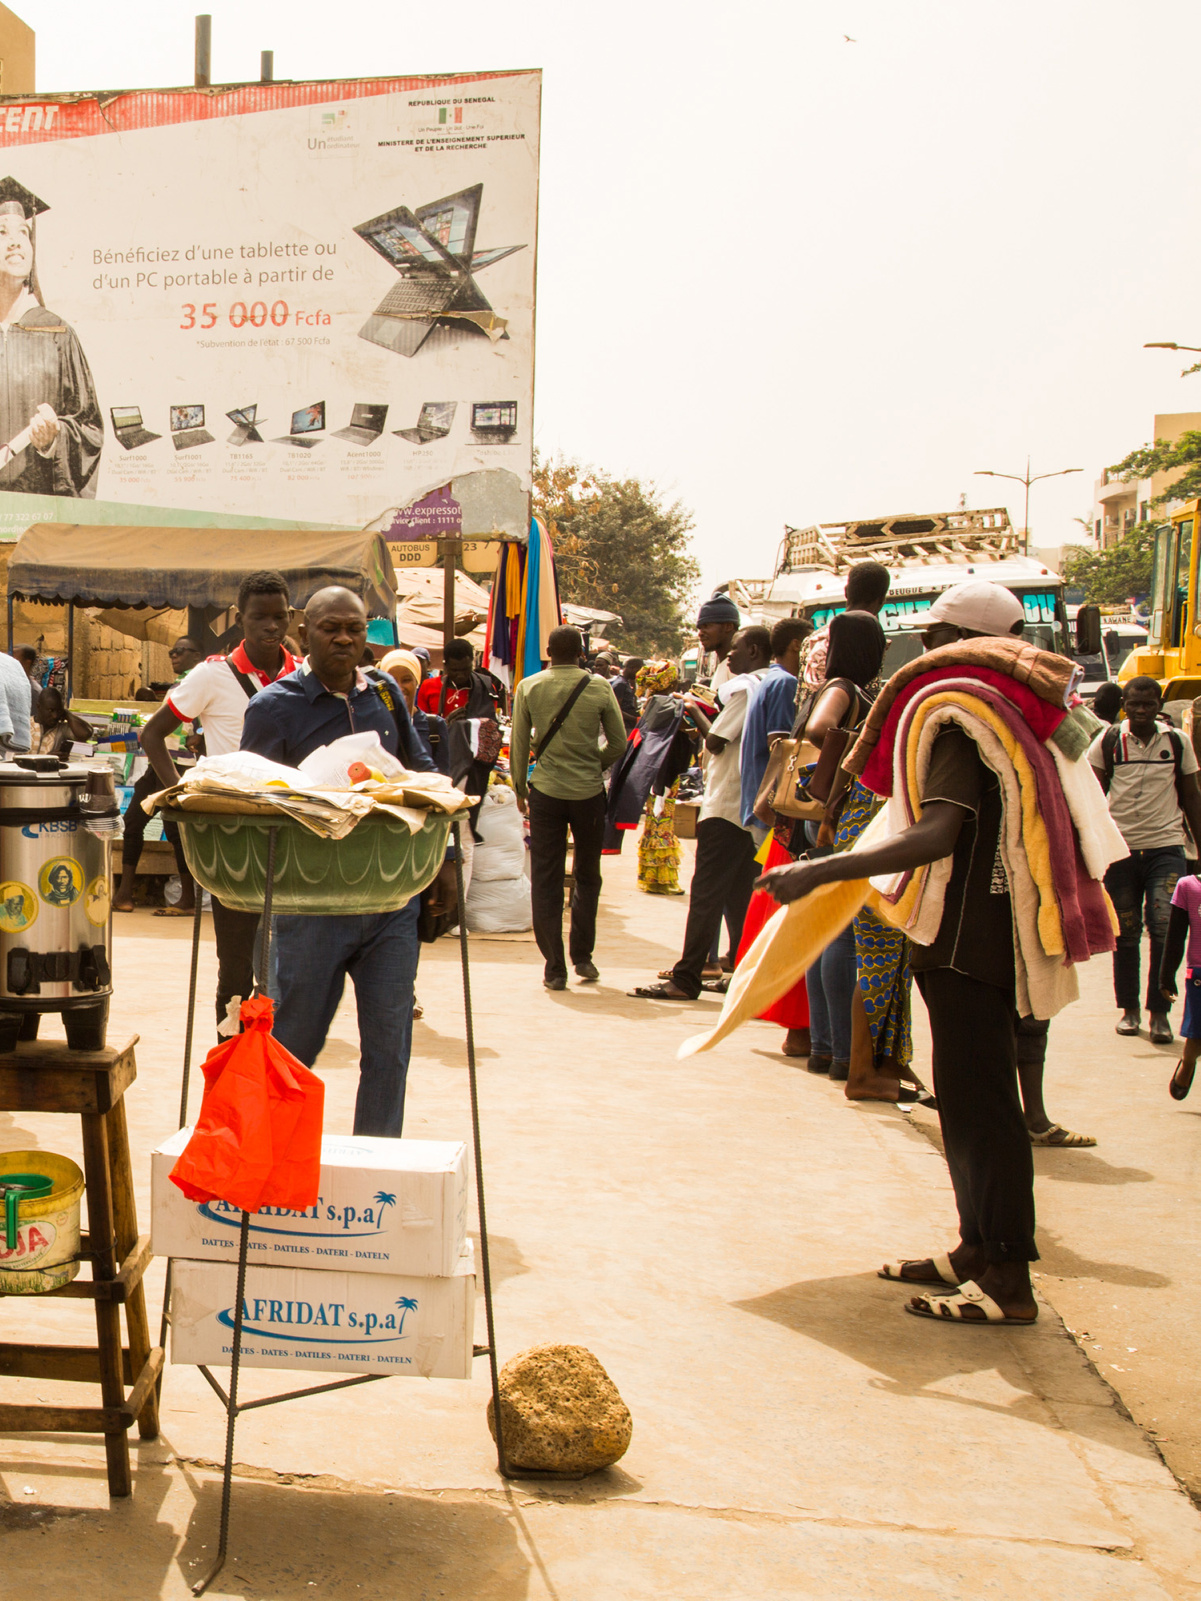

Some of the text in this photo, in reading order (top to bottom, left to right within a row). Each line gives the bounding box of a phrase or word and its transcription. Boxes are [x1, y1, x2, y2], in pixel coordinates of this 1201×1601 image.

[408, 98, 451, 107] REPUBLIQUE
[464, 96, 495, 104] SENEGAL
[308, 137, 326, 150] Un
[426, 136, 485, 145] L'ENSEIGNEMENT
[487, 134, 525, 142] SUPERIEUR
[446, 143, 487, 151] RECHERCHE
[93, 247, 180, 265] Bénéficiez
[240, 242, 309, 259] tablette
[314, 243, 337, 255] ou
[136, 272, 158, 288] PC
[164, 269, 238, 291] portable
[243, 268, 253, 284] à
[258, 266, 307, 287] partir
[312, 265, 334, 281] de
[179, 300, 332, 330] 35 000 Fcfa
[247, 338, 258, 347] de
[284, 337, 295, 346] 67
[297, 337, 313, 346] 500
[314, 336, 331, 345] Fcfa
[3, 513, 14, 521] 77
[15, 513, 30, 521] 322
[31, 512, 42, 521] 67
[43, 512, 54, 520] 07
[391, 544, 430, 552] AUTOBUS
[463, 543, 478, 552] 23
[399, 553, 422, 562] DDD
[39, 820, 78, 832] KBSB
[326, 1204, 375, 1229] s.p.a
[201, 1238, 390, 1261] DATTES ATES DATILES DATERI DATELN
[241, 1297, 397, 1335] AFRIDAT s.p.a
[222, 1345, 412, 1364] DATES DATES DATILES DATERI DATELN
